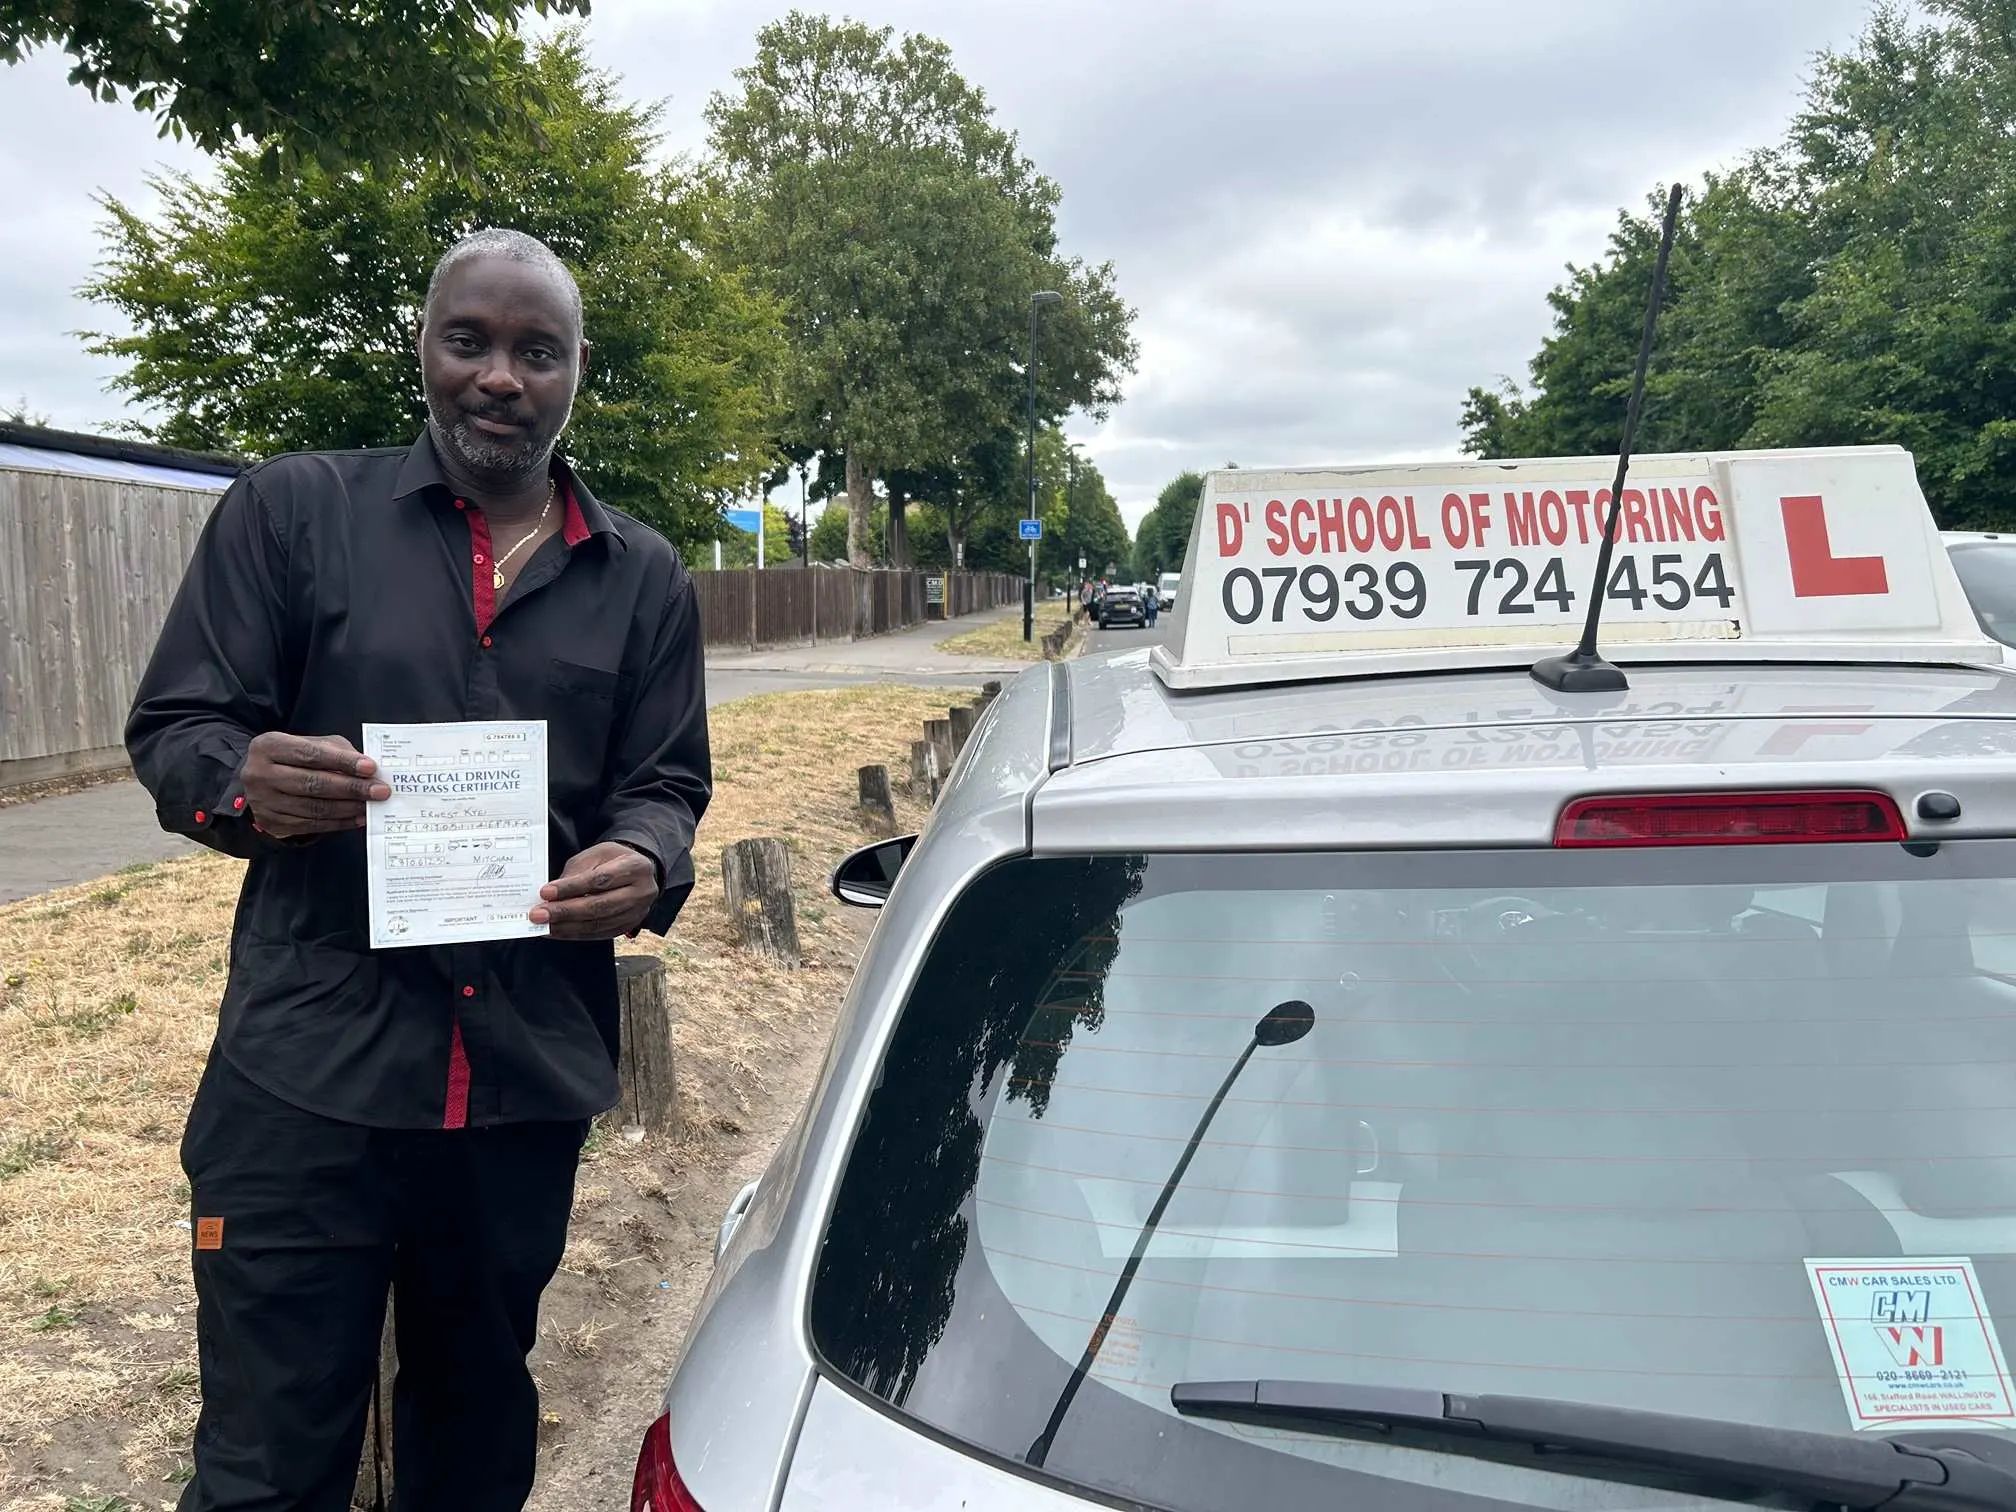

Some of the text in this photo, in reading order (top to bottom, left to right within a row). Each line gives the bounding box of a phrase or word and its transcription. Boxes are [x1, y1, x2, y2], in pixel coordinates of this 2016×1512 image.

[1216, 485, 1725, 557] D' SCHOOL OF MOTORING
[1779, 495, 1889, 598] L
[1222, 553, 1735, 625] 07939 724 454
[392, 769, 520, 784] PRACTICAL DRIVING
[394, 780, 520, 793] TEST PASS CERTIFICATE
[1829, 1277, 1859, 1287] CMW
[1862, 1276, 1888, 1286] CAR
[1892, 1275, 1931, 1286] SALES
[1871, 1290, 1931, 1323] CM
[1873, 1404, 1930, 1412] SPECIALISTS
[1942, 1403, 1966, 1411] USED
